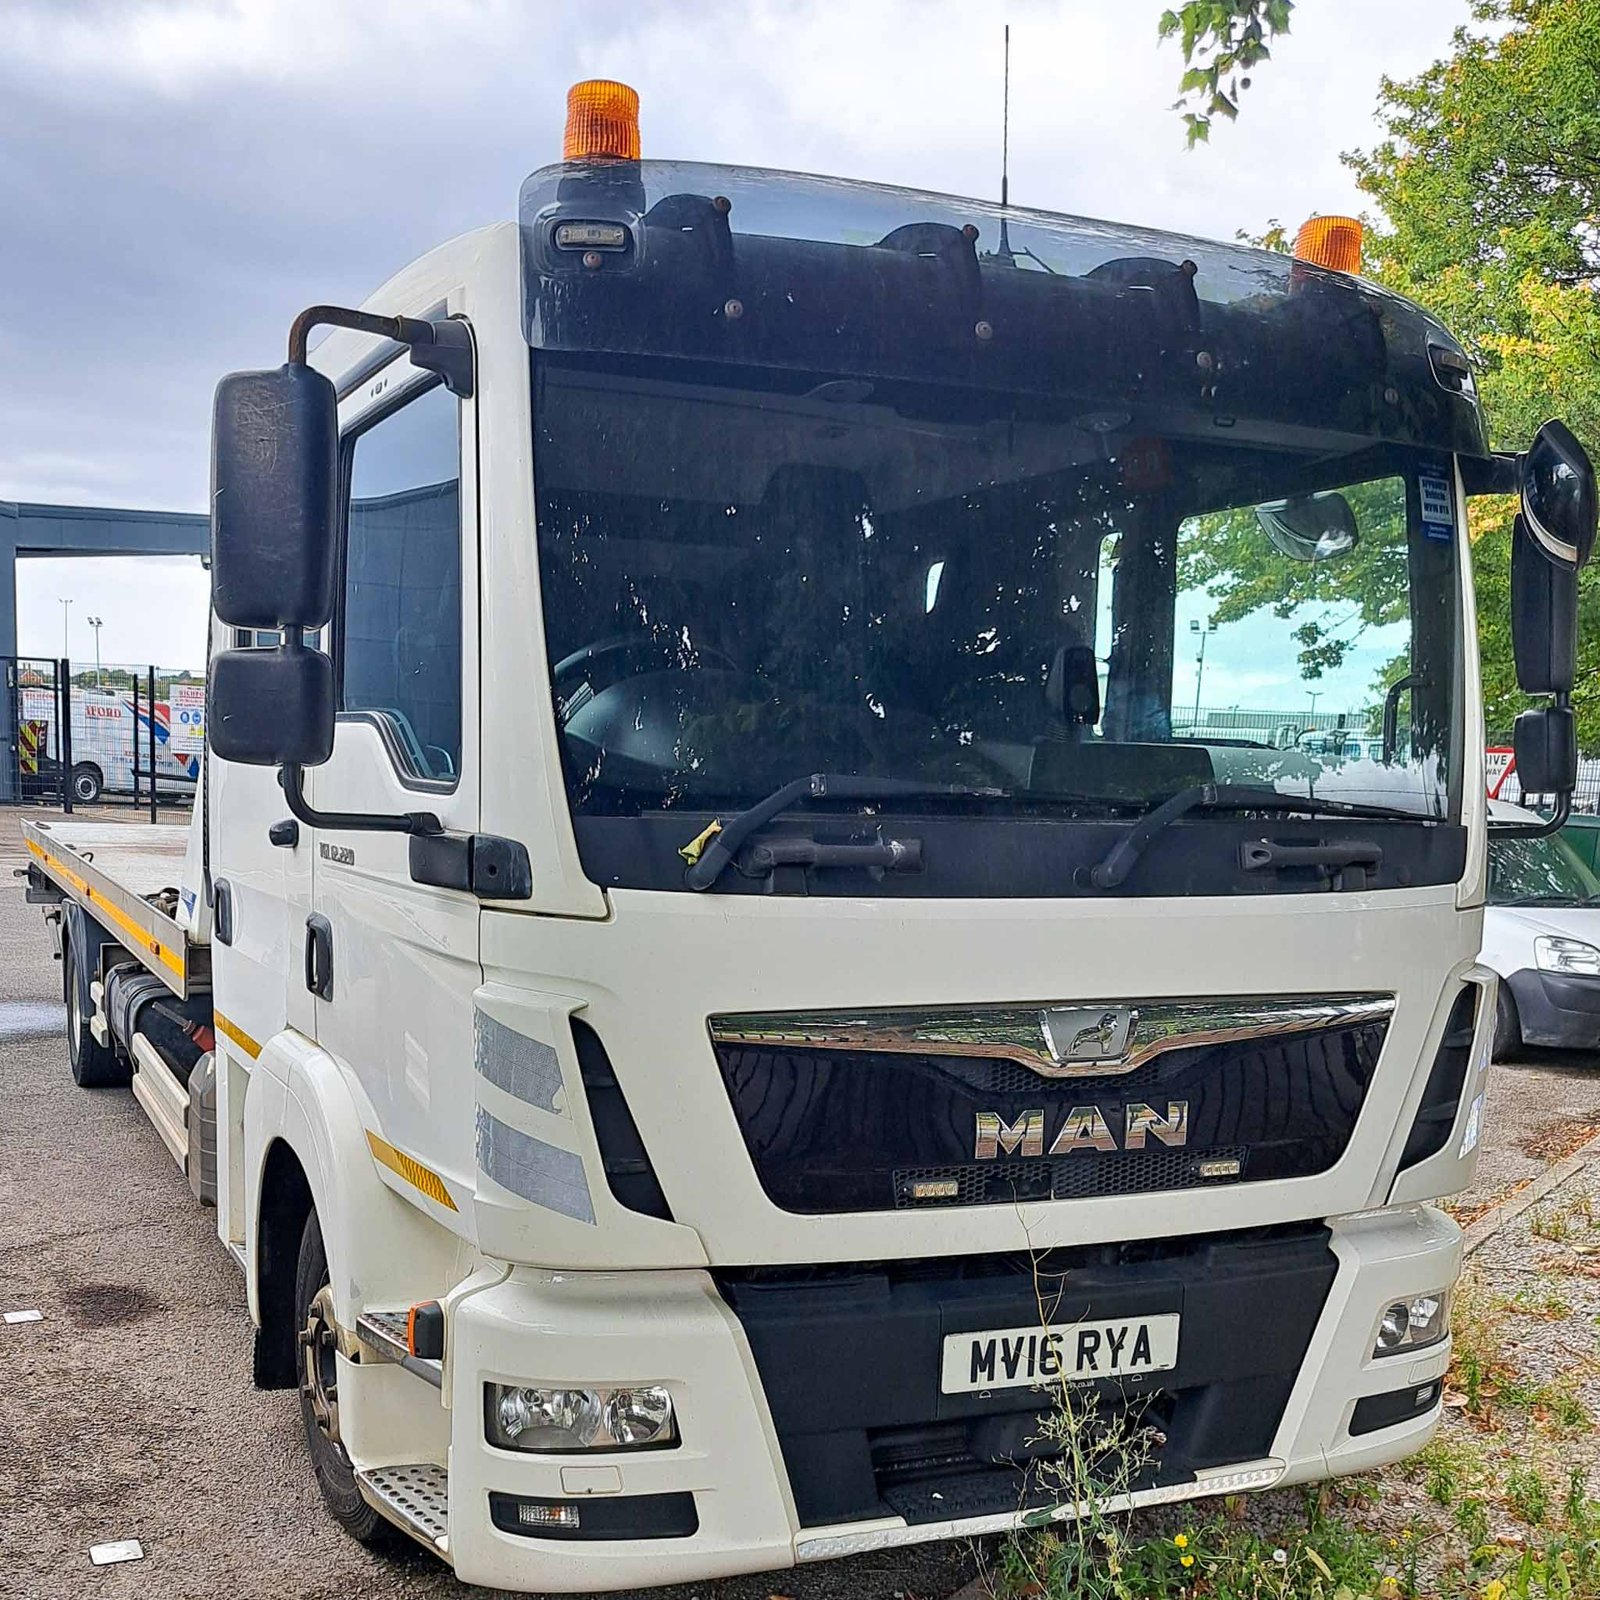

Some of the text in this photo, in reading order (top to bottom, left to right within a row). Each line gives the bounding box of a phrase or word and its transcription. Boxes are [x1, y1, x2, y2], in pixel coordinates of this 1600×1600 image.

[975, 1101, 1188, 1159] MAN
[970, 1324, 1152, 1383] MV16 RYA
